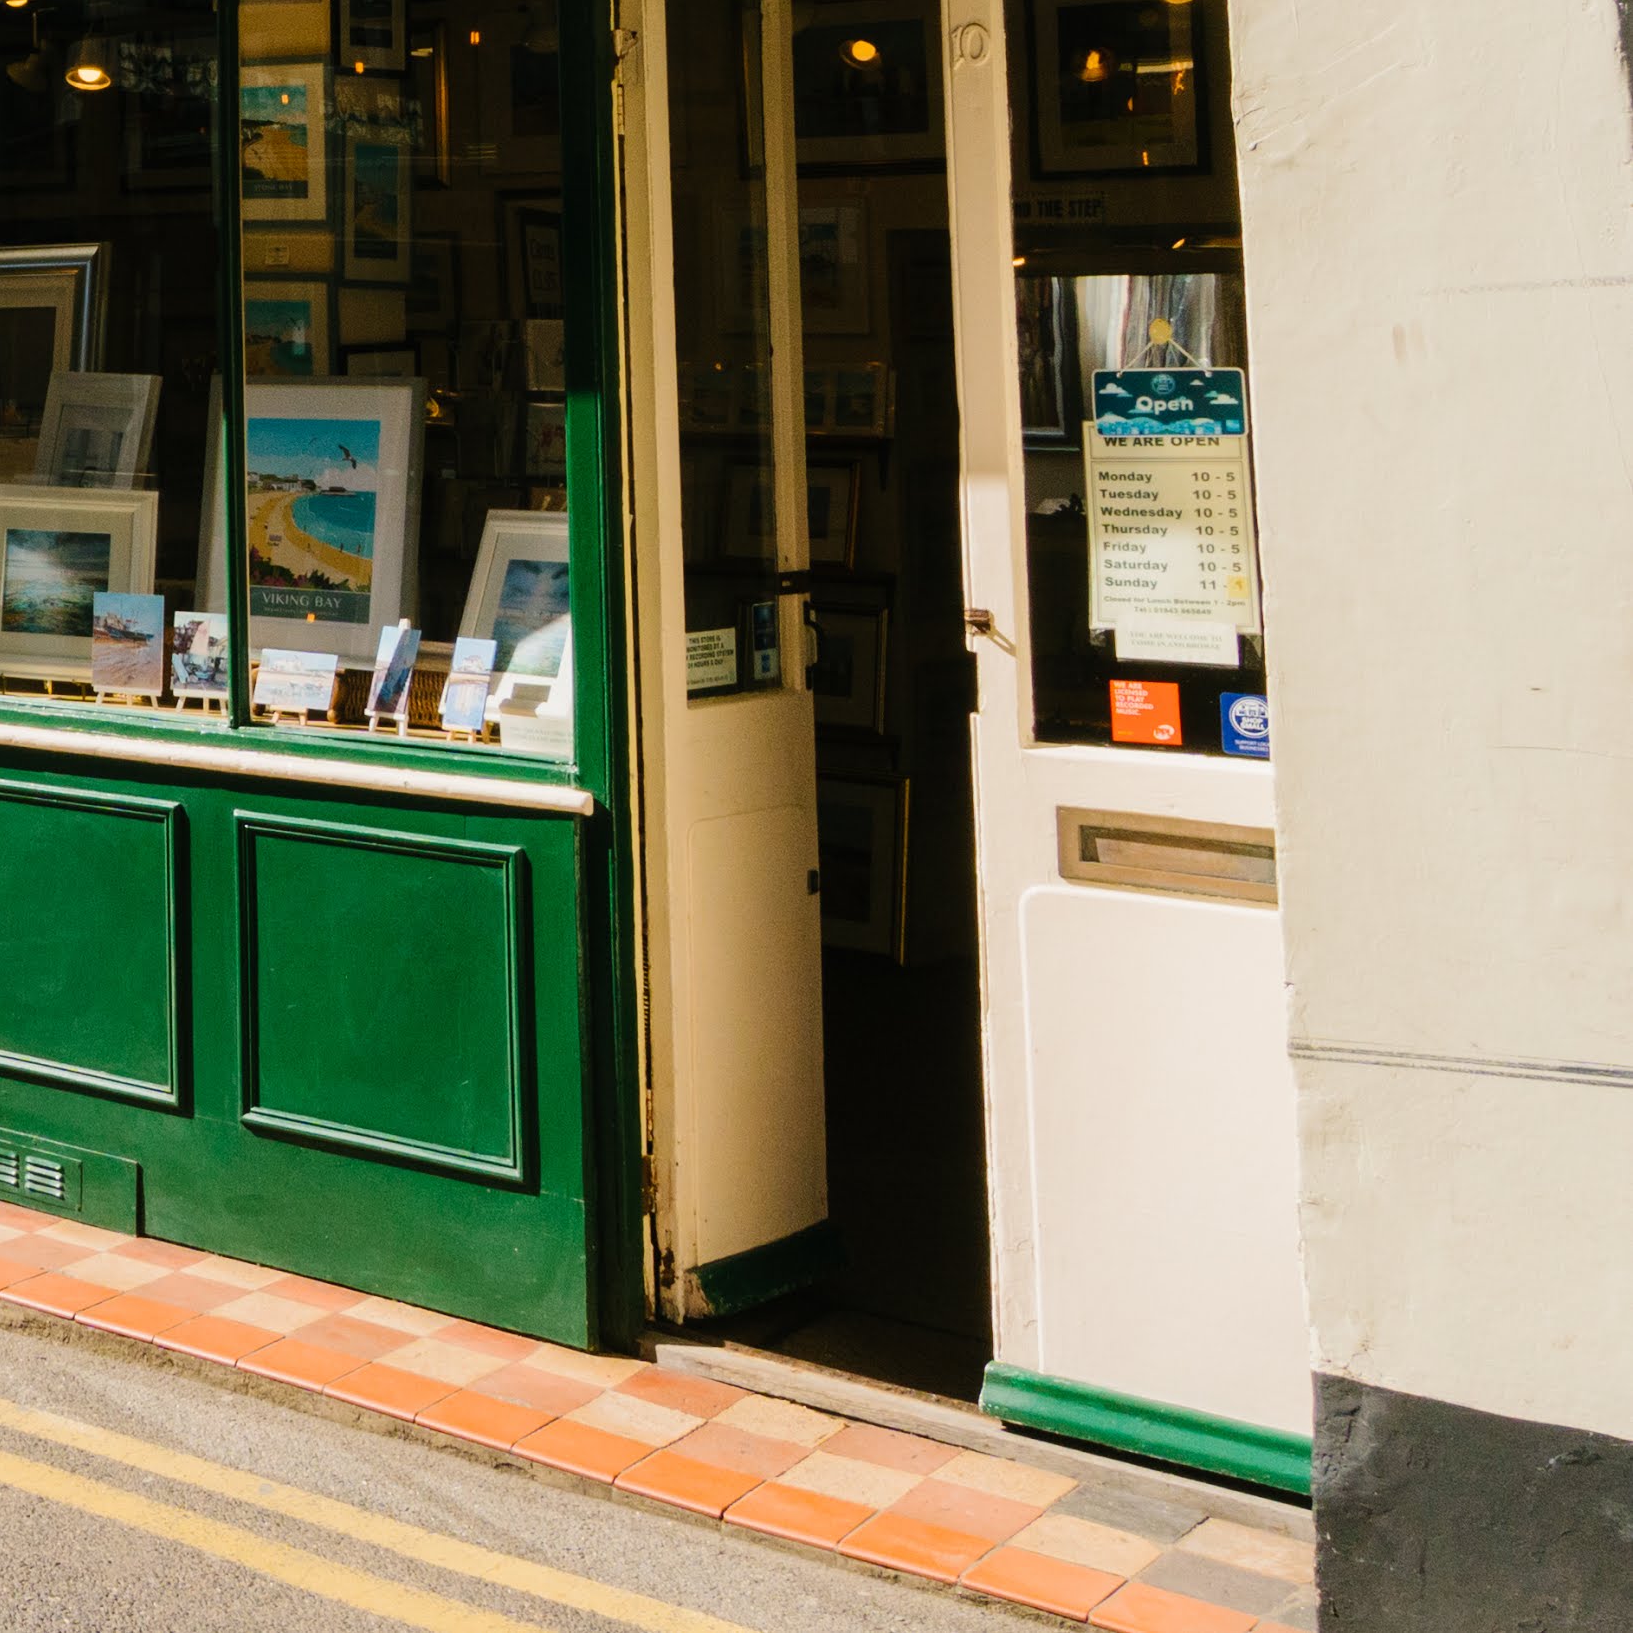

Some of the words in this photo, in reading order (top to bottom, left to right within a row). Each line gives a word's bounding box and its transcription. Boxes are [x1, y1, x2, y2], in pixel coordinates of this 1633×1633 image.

[1038, 200, 1063, 217] THE
[1068, 199, 1103, 217] STEP
[1135, 396, 1194, 415] Open
[1098, 472, 1152, 484] Monday
[1192, 472, 1210, 482] 10
[1226, 472, 1235, 482] 5
[1099, 489, 1159, 501] Tuesday
[1193, 490, 1211, 500] 10
[1227, 490, 1236, 500] 5
[1101, 507, 1183, 520] Wednesday
[1194, 508, 1213, 518] 10
[1229, 508, 1238, 518] 5
[1102, 524, 1168, 537] Thursday
[1196, 526, 1214, 536] 10
[1230, 526, 1239, 536] 5
[1103, 542, 1147, 554] Friday
[1197, 544, 1215, 553] 10
[1231, 544, 1240, 554] 5
[1104, 559, 1168, 572] Saturday
[1198, 562, 1216, 572] 10
[1232, 562, 1242, 572] 5
[1105, 577, 1158, 590] Sunday
[1200, 580, 1216, 590] 11
[262, 591, 310, 606] VIKING
[315, 596, 342, 608] BAY
